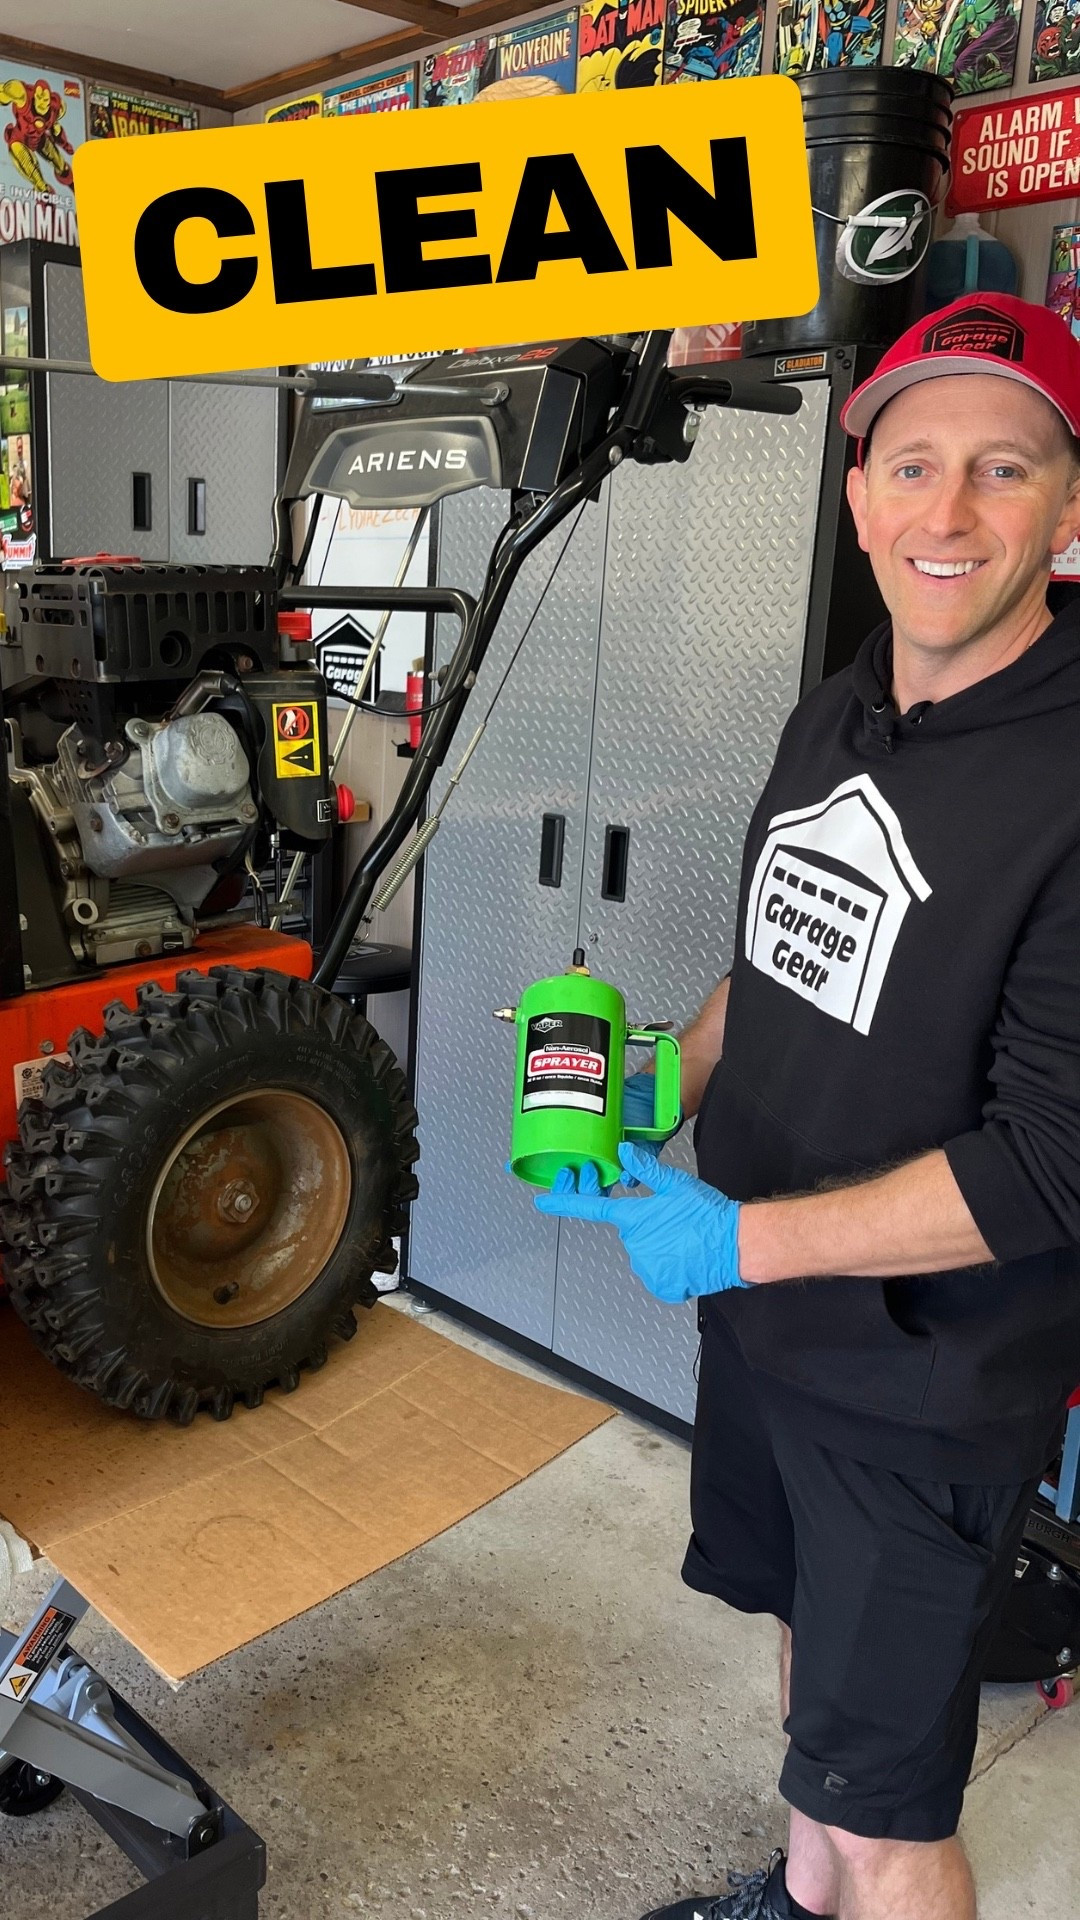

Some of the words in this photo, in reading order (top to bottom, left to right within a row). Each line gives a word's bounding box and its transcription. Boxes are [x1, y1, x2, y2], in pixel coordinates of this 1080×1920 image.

[581, 10, 618, 55] BAT
[627, 0, 667, 36] MAN
[500, 27, 570, 78] WOLVERINE
[112, 99, 128, 110] THE
[132, 104, 179, 122] INVINCIBLE
[341, 99, 357, 112] THE
[360, 84, 406, 105] INVINCIBLE
[979, 101, 1062, 143] ALARM
[962, 136, 1039, 174] SOUND
[1049, 129, 1072, 158] IF
[987, 170, 1008, 199] IS
[1020, 157, 1080, 193] OPEN
[10, 185, 73, 207] INVINCIBLE
[0, 198, 30, 242] ON
[786, 356, 823, 369] GLADIATOR
[348, 450, 467, 475] ARIENS
[326, 665, 362, 684] Garag
[333, 681, 357, 696] Gea
[765, 893, 857, 962] Garage
[772, 939, 829, 992] Gear
[546, 1045, 588, 1054] Non-Aerosol
[533, 1057, 598, 1071] SPRAYER
[1027, 1520, 1070, 1543] BURGH
[25, 1617, 50, 1650] WARNING
